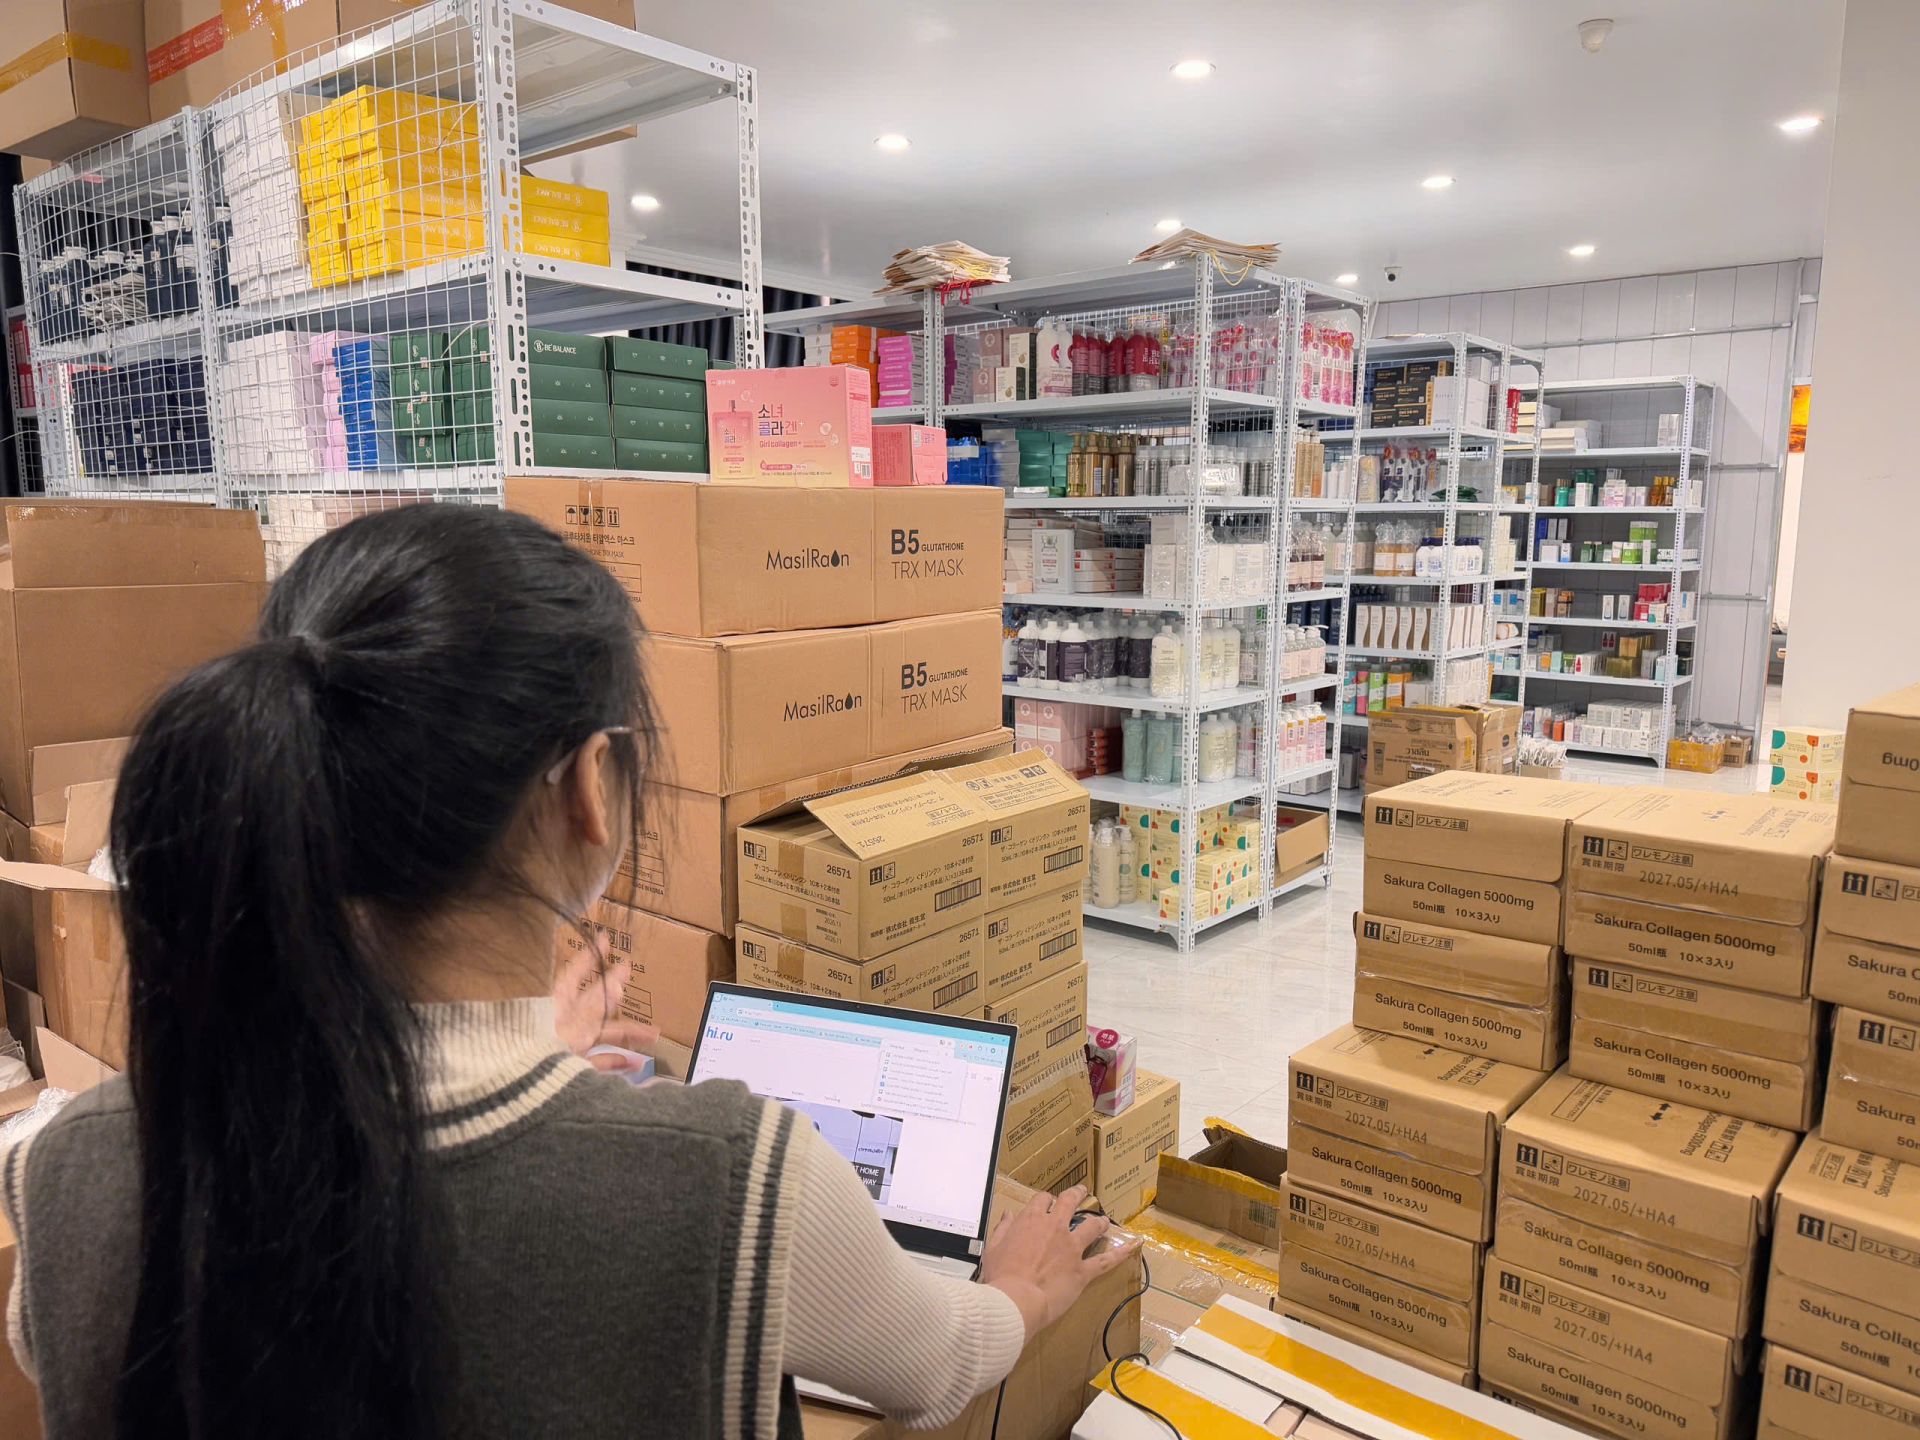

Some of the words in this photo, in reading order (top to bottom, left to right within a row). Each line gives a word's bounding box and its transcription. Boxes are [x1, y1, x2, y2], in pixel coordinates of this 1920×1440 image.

[552, 345, 577, 355] BALANCE
[758, 403, 783, 419] 소녀
[891, 529, 919, 555] B5
[921, 542, 964, 552] GLUTATHIONE
[891, 561, 920, 580] TRX
[924, 559, 965, 578] MASK
[901, 662, 927, 689] B5
[929, 668, 968, 683] GLUTATHIONE
[901, 696, 926, 714] TRX
[931, 685, 968, 704] MASK
[1067, 805, 1086, 817] 26571
[962, 833, 984, 847] 26571
[826, 864, 852, 879] 26571
[1581, 857, 1625, 872] 賞味期限
[1061, 889, 1079, 903] 26571
[1384, 874, 1424, 890] Sakura
[1428, 881, 1481, 899] Collagen
[1484, 890, 1534, 910] 5000mg
[959, 927, 980, 943] 26571
[1594, 912, 1642, 931] Sakura
[1646, 922, 1710, 943] Collagen
[1714, 933, 1776, 956] 5000mg
[827, 968, 853, 985] 26571
[1848, 954, 1906, 978] Sakura
[1067, 975, 1084, 989] 26571
[1637, 980, 1697, 1001] ワレモノ注意
[1375, 992, 1414, 1012] Sakura
[1417, 1003, 1469, 1024] Collagen
[1472, 1016, 1522, 1039] 5000mg
[706, 1026, 733, 1041] hi.ru
[1593, 1036, 1641, 1057] Sakura
[1645, 1048, 1707, 1072] Collagen
[1711, 1064, 1771, 1089] 5000mg
[1296, 1092, 1332, 1109] 賞味期限
[1856, 1100, 1915, 1126] Sakura
[860, 1166, 880, 1177] HOME
[863, 1177, 877, 1186] WAY
[1312, 1147, 1352, 1168] Sakura
[1354, 1160, 1408, 1185] Collagen
[1411, 1177, 1462, 1204] 5000mg
[1515, 1166, 1560, 1188] 賞味期限
[1567, 1162, 1630, 1191] ワレモノ注意
[1289, 1212, 1325, 1231] 賞味期限
[1524, 1220, 1573, 1247] Sakura
[1577, 1237, 1642, 1271] Collagen
[1646, 1257, 1710, 1293] 5000mg
[1300, 1261, 1340, 1285] Sakura
[1342, 1277, 1394, 1306] Collagen
[1397, 1298, 1447, 1328] 5000mg
[1499, 1293, 1541, 1316] 賞味期限
[1549, 1295, 1609, 1324] ワレモノ注意
[1800, 1299, 1860, 1331] Sakura
[1507, 1346, 1555, 1375] Sakura
[1559, 1366, 1622, 1401] Collagen
[1625, 1392, 1686, 1428] 5000mg
